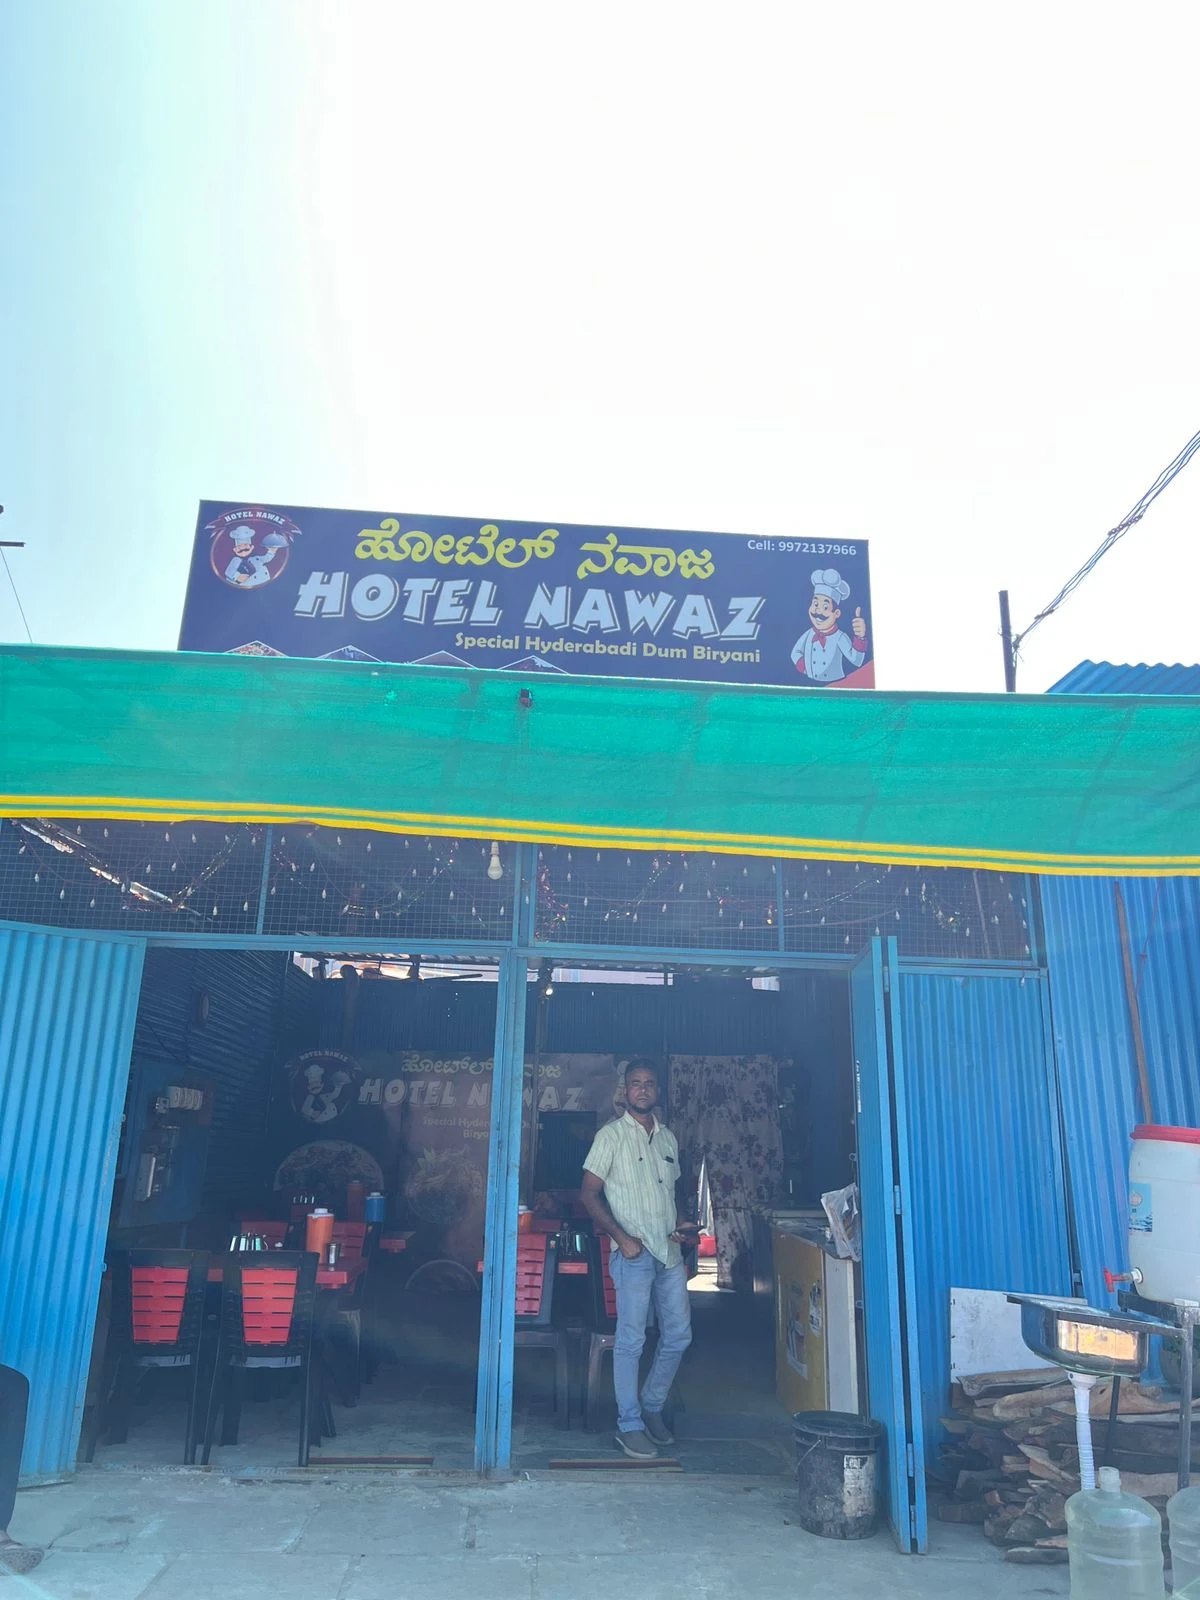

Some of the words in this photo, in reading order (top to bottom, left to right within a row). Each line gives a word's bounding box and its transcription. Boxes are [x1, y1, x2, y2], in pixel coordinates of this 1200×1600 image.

[224, 511, 253, 522] HOTEL
[256, 511, 286, 525] NAWAZ
[355, 518, 560, 568] ಹೋಟೆಲ್
[747, 539, 775, 551] Cell:
[778, 541, 857, 556] 9972137966
[294, 571, 503, 626] HOTEL
[523, 582, 766, 641] NAWAZ
[455, 632, 519, 649] Special
[525, 636, 637, 656] Hyderabadi
[643, 642, 687, 659] Dum
[693, 645, 761, 663] Biryani
[357, 1079, 457, 1108] HOTEL
